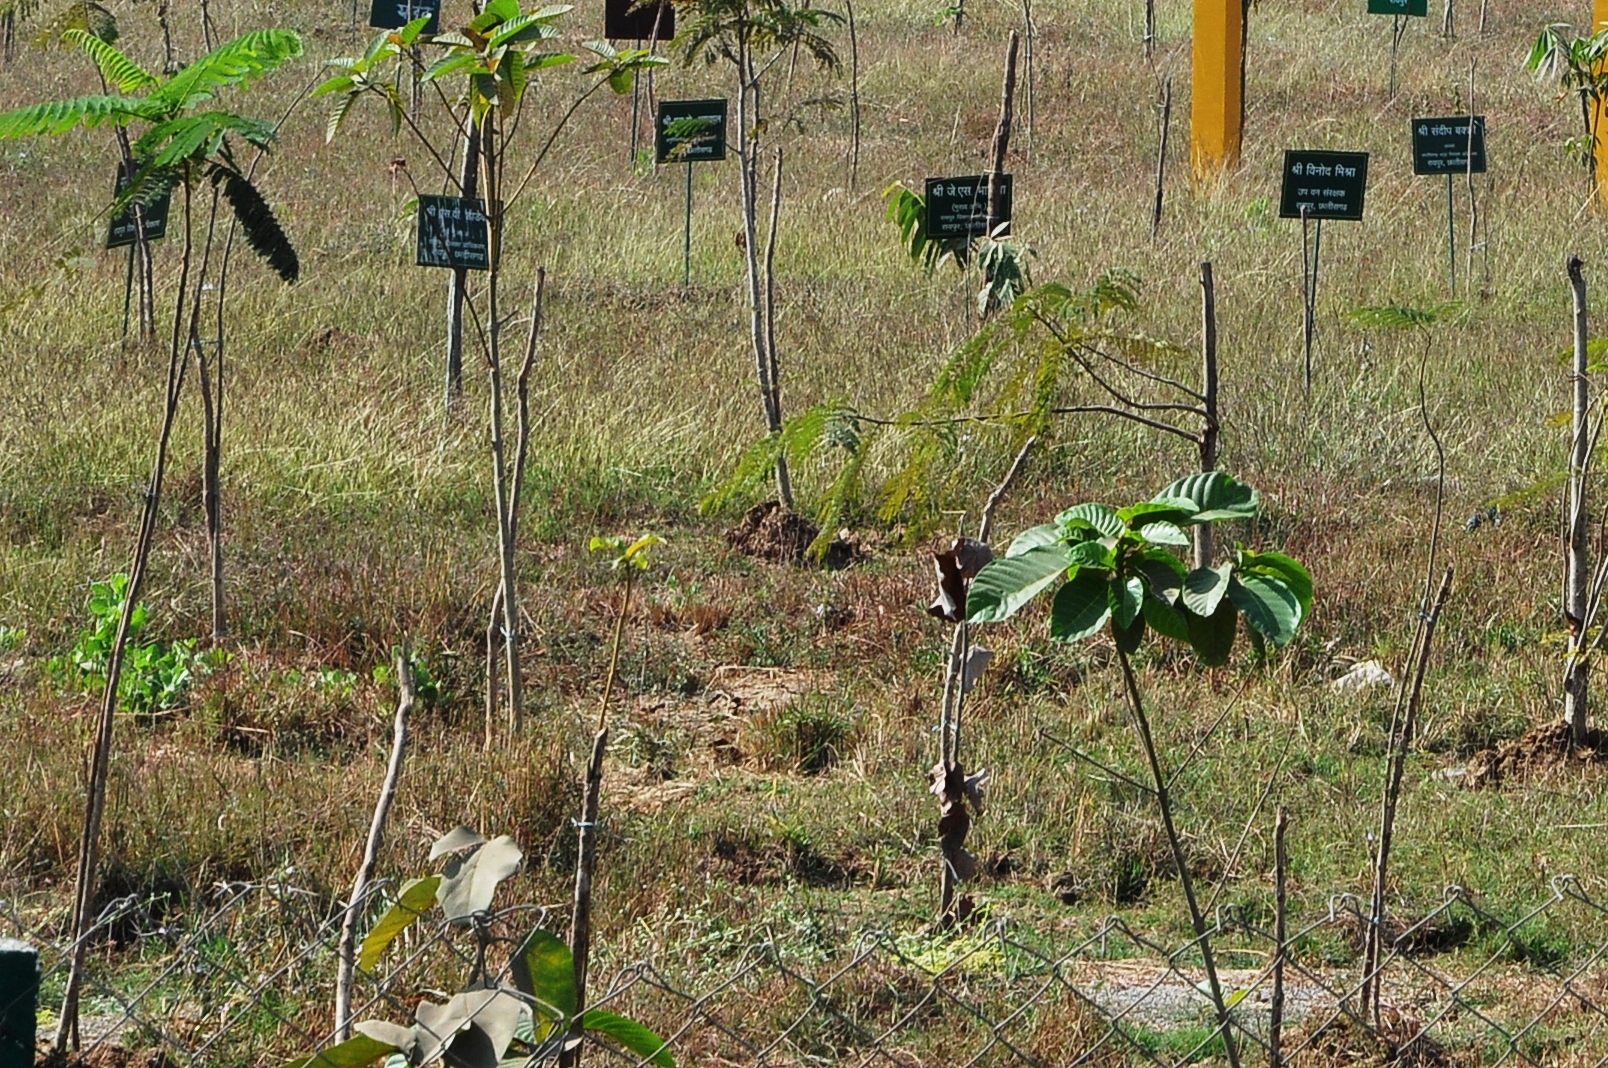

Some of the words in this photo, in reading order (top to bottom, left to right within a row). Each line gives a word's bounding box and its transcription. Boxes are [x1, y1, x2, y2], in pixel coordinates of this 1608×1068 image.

[1418, 123, 1428, 136] श्री
[1431, 124, 1453, 136] संदीप
[1291, 161, 1303, 176] श्री
[1306, 162, 1332, 176] विनोद
[1334, 163, 1357, 178] मिश्रा
[932, 183, 944, 197] श्री
